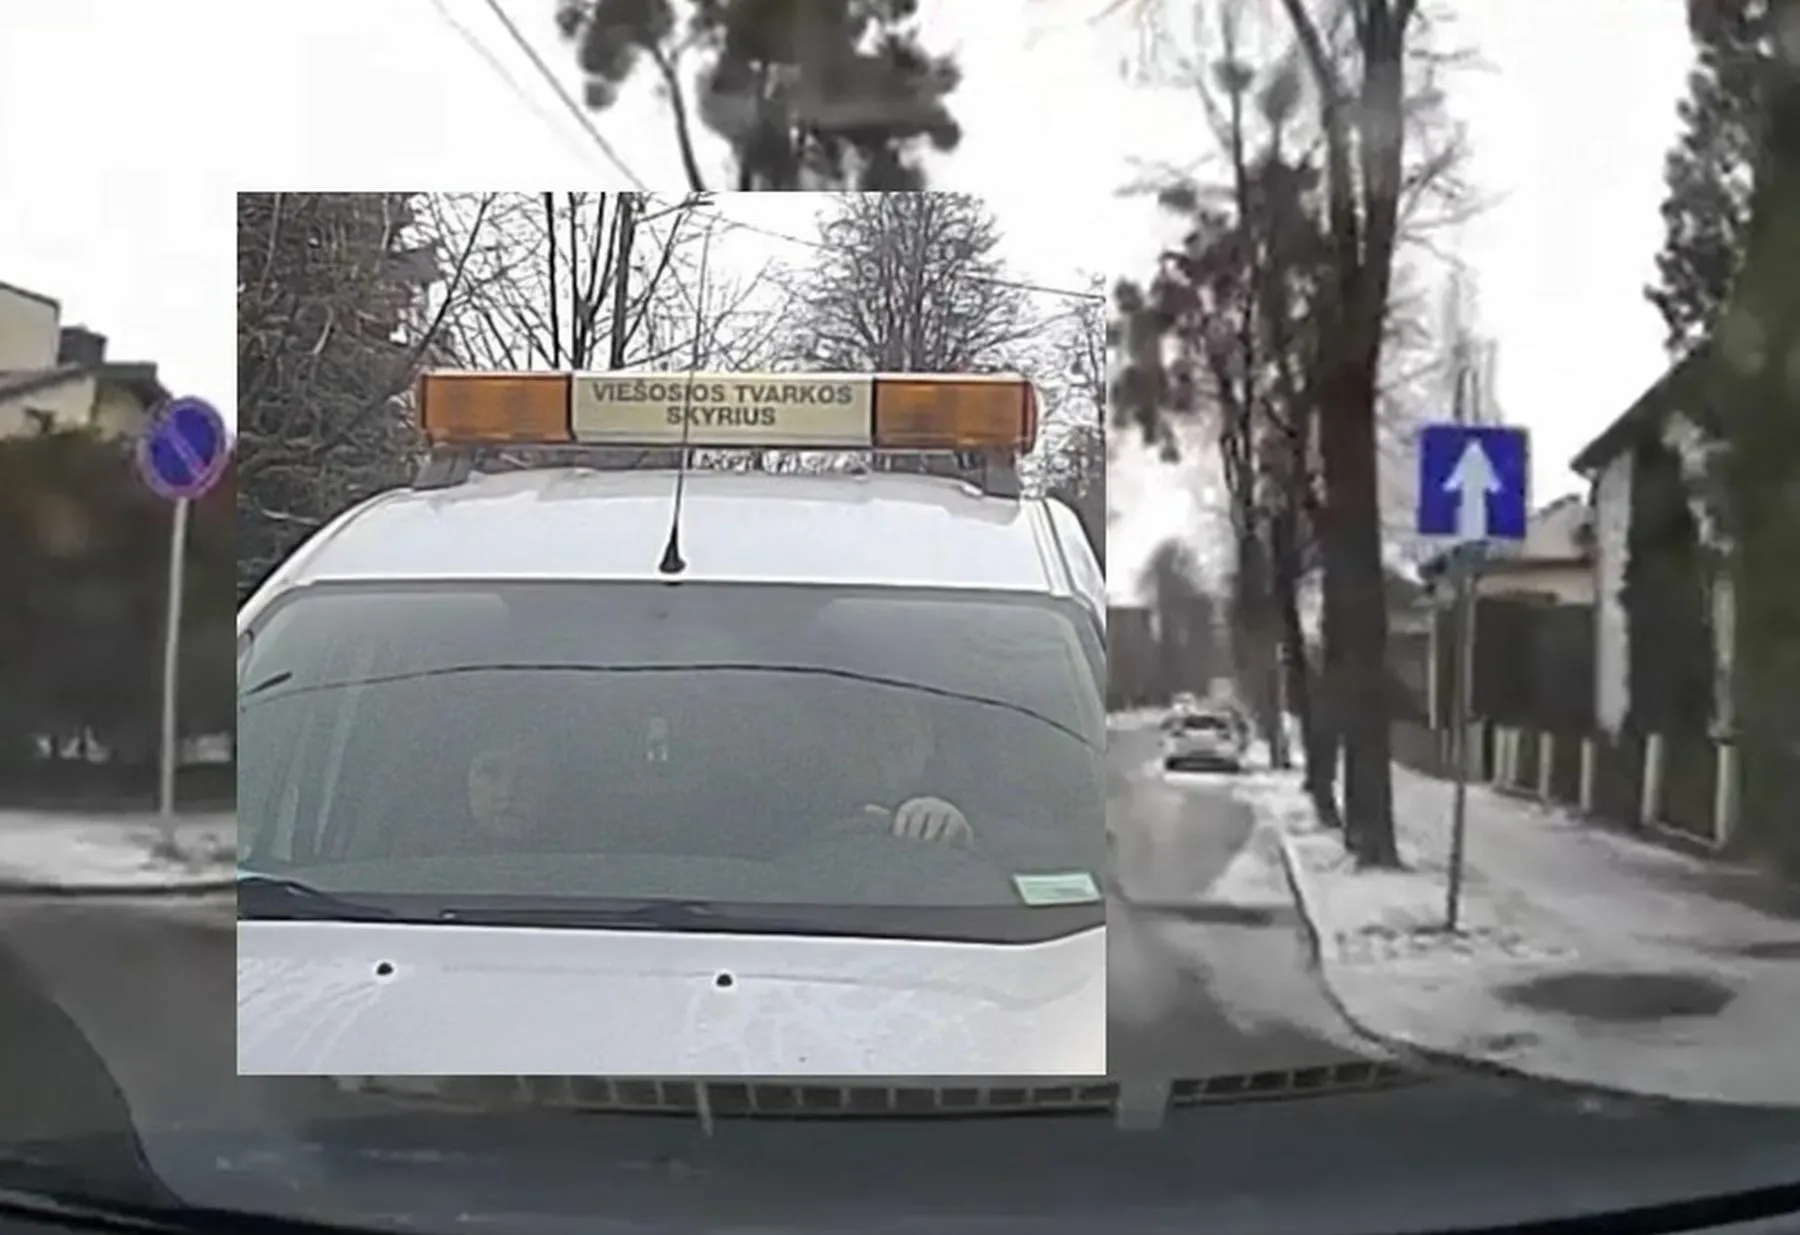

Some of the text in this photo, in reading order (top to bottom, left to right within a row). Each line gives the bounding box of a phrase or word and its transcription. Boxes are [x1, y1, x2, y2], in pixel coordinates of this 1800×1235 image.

[592, 379, 853, 405] VIEŠOSIOS TVARKOS
[666, 406, 776, 427] SKYRIUS
